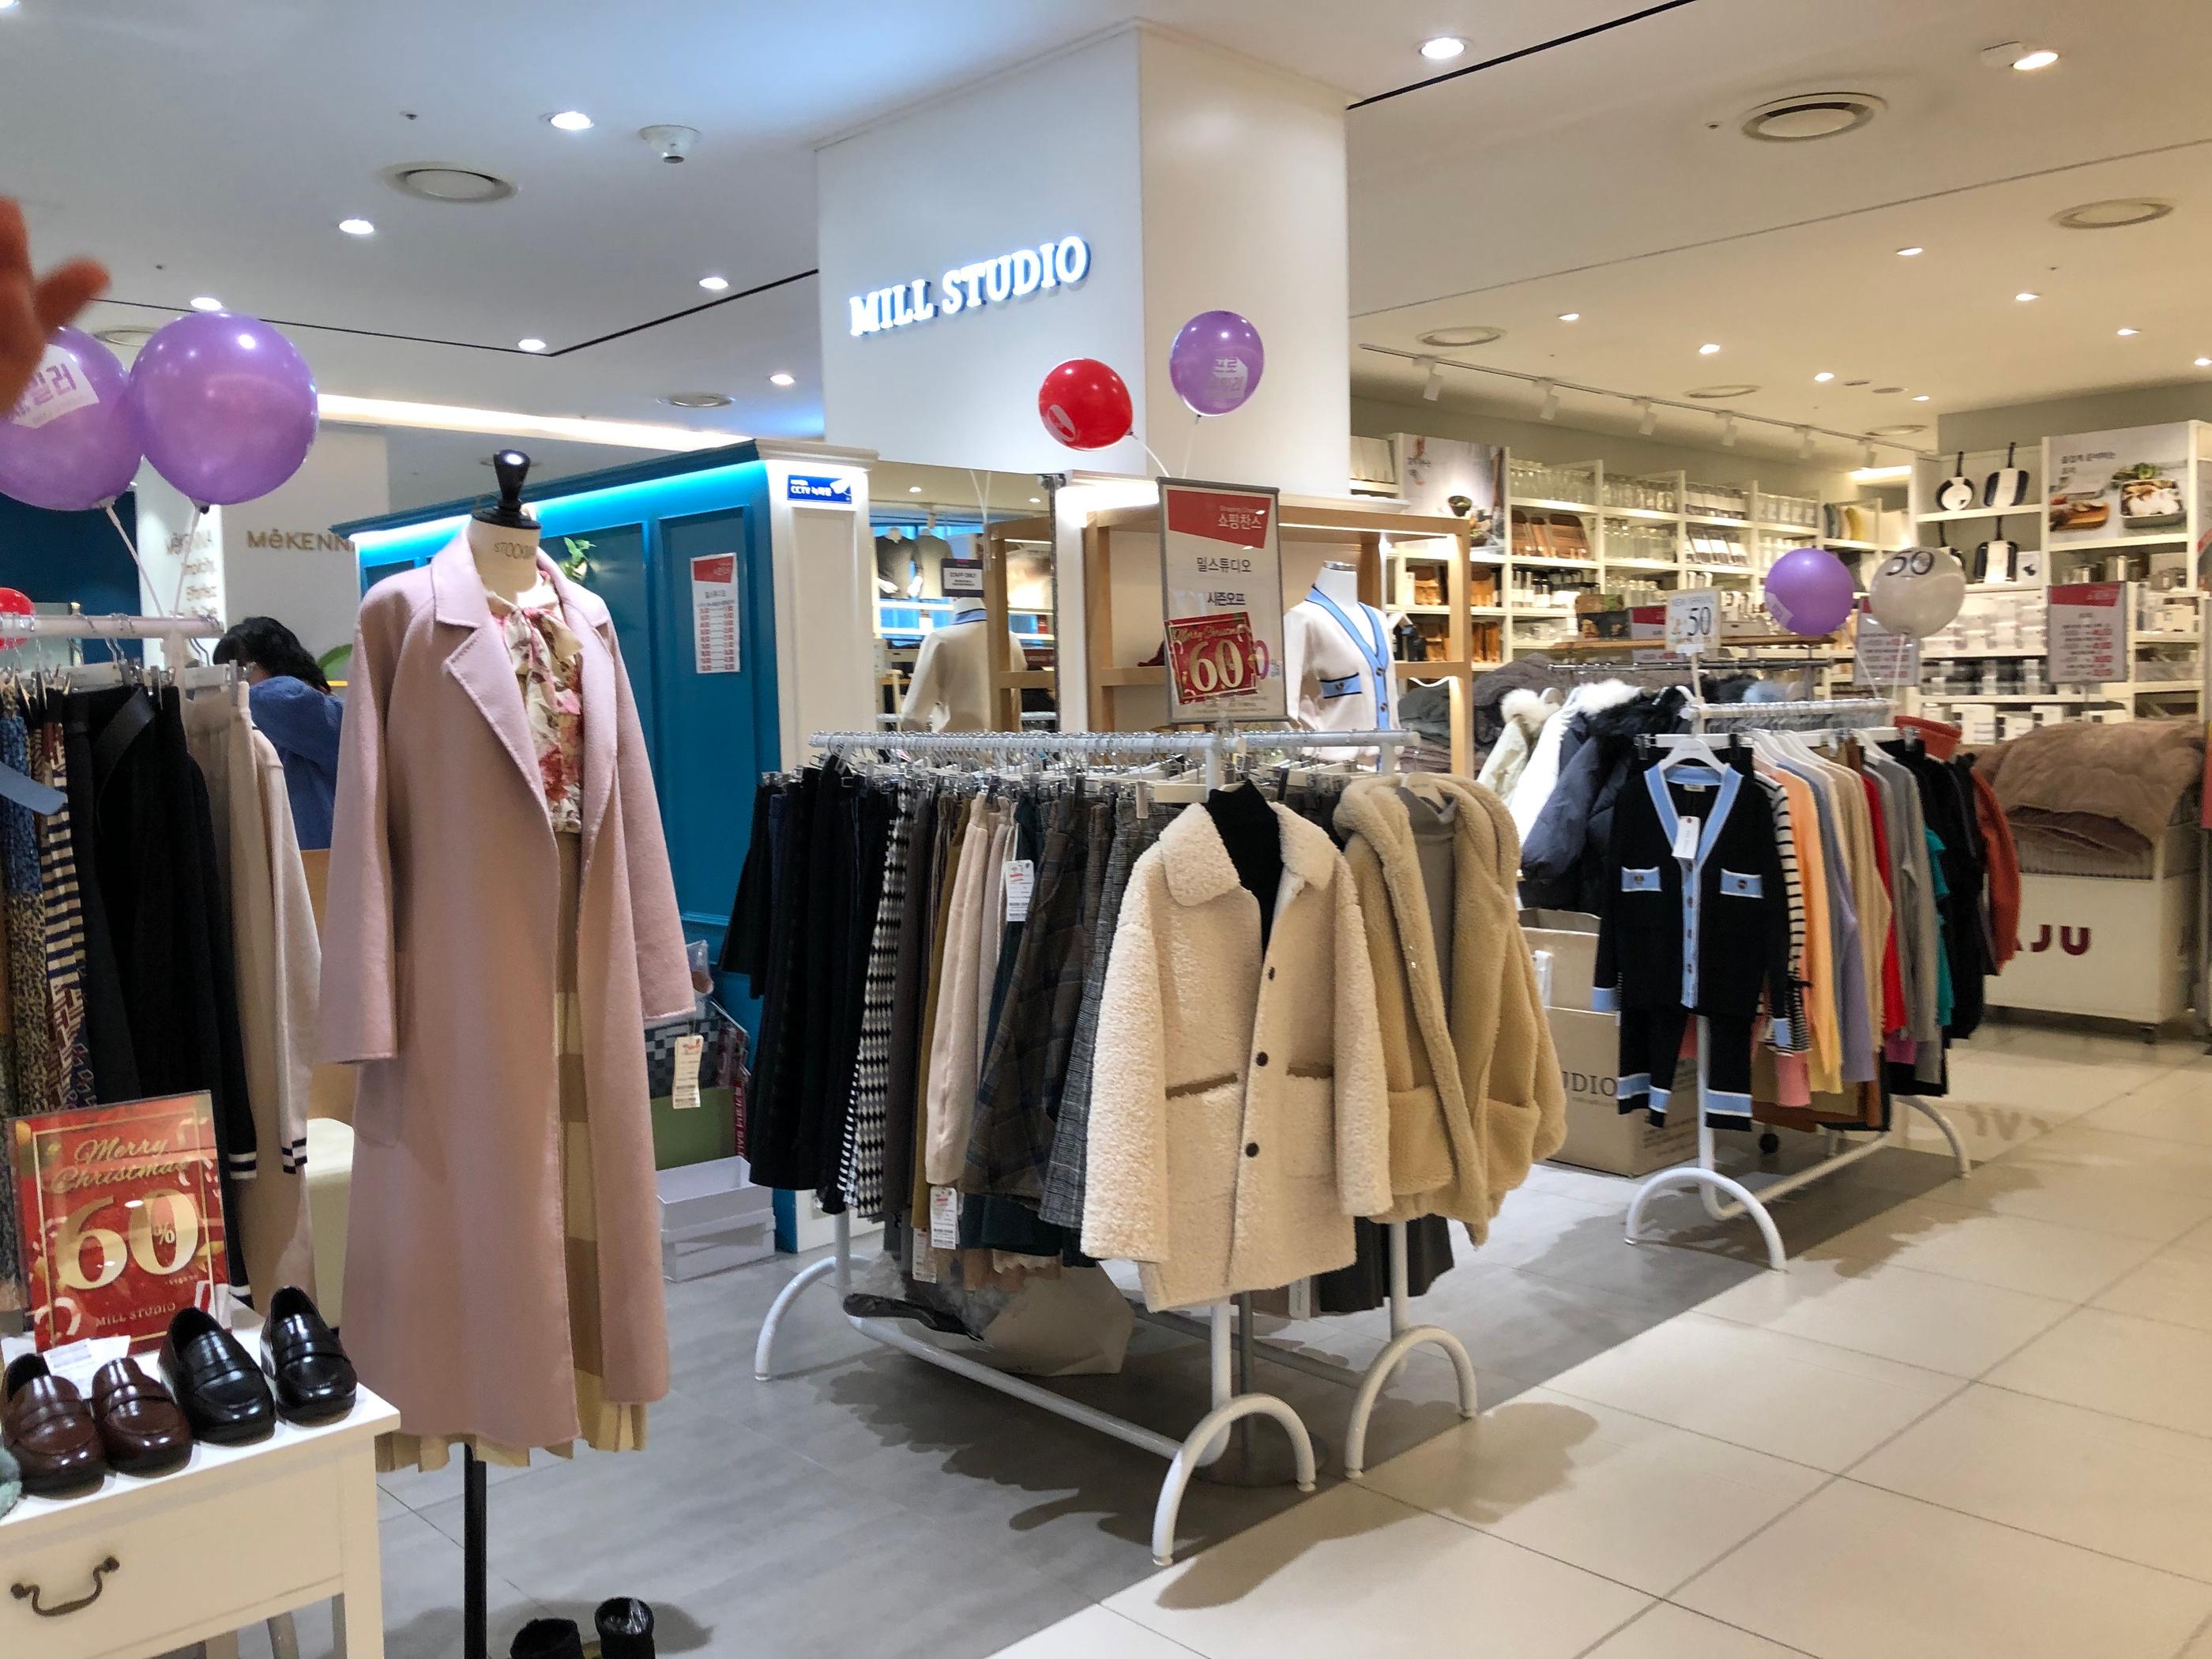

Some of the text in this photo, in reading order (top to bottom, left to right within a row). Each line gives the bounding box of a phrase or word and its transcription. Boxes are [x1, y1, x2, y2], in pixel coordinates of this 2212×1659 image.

[849, 235, 1089, 337] MILL STUDIO
[1217, 514, 1262, 529] 쇼핑찬스
[1197, 557, 1251, 573] 밀스튜디오
[1885, 550, 1934, 576] 50
[1207, 592, 1246, 606] 시즌오프
[1687, 606, 1711, 636] 50
[2014, 924, 2092, 956] JU
[74, 1137, 168, 1166] Merry
[96, 1302, 176, 1328] MILL STUDIO
